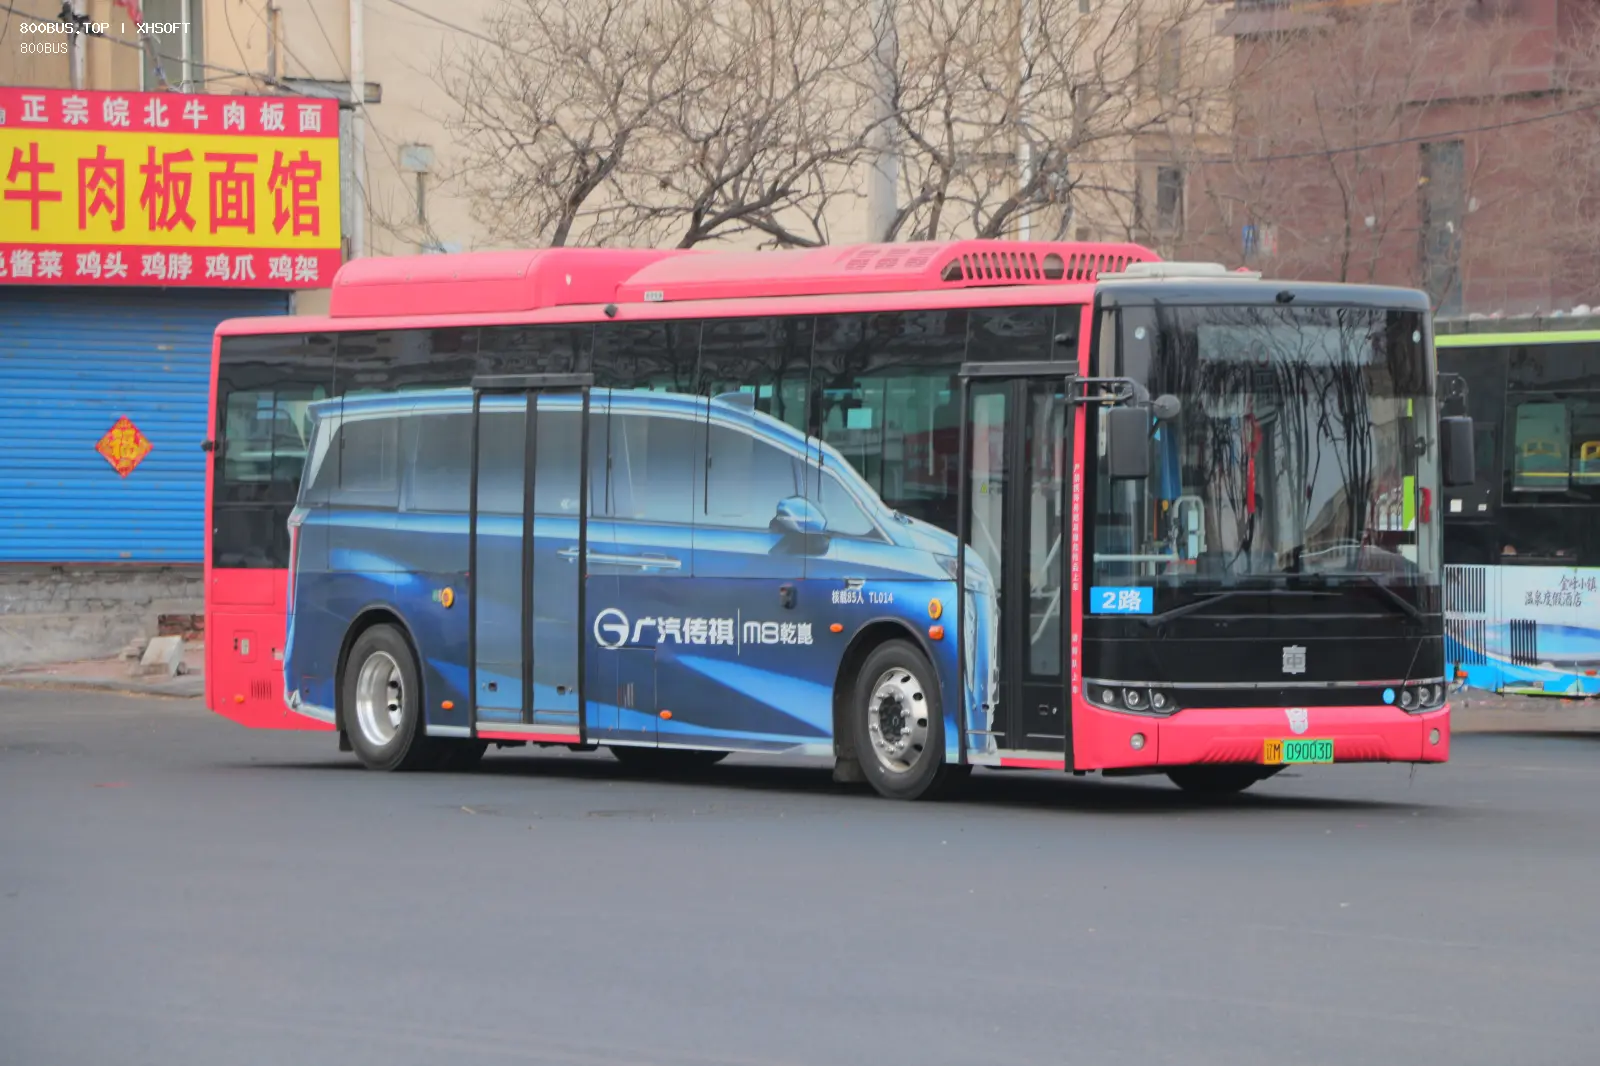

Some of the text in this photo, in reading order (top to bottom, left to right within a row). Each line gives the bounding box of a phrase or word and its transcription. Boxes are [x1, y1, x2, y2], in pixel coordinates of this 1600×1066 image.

[4, 142, 322, 236] 牛肉板面馆
[76, 250, 128, 279] 鸡头
[141, 251, 192, 280] 鸡脖
[205, 253, 256, 281] 鸡爪
[268, 254, 319, 282] 鸡架
[869, 591, 894, 604] TL014
[1102, 589, 1141, 611] 2路
[631, 616, 735, 645] 广汽传祺
[1286, 742, 1332, 760] 09003D
